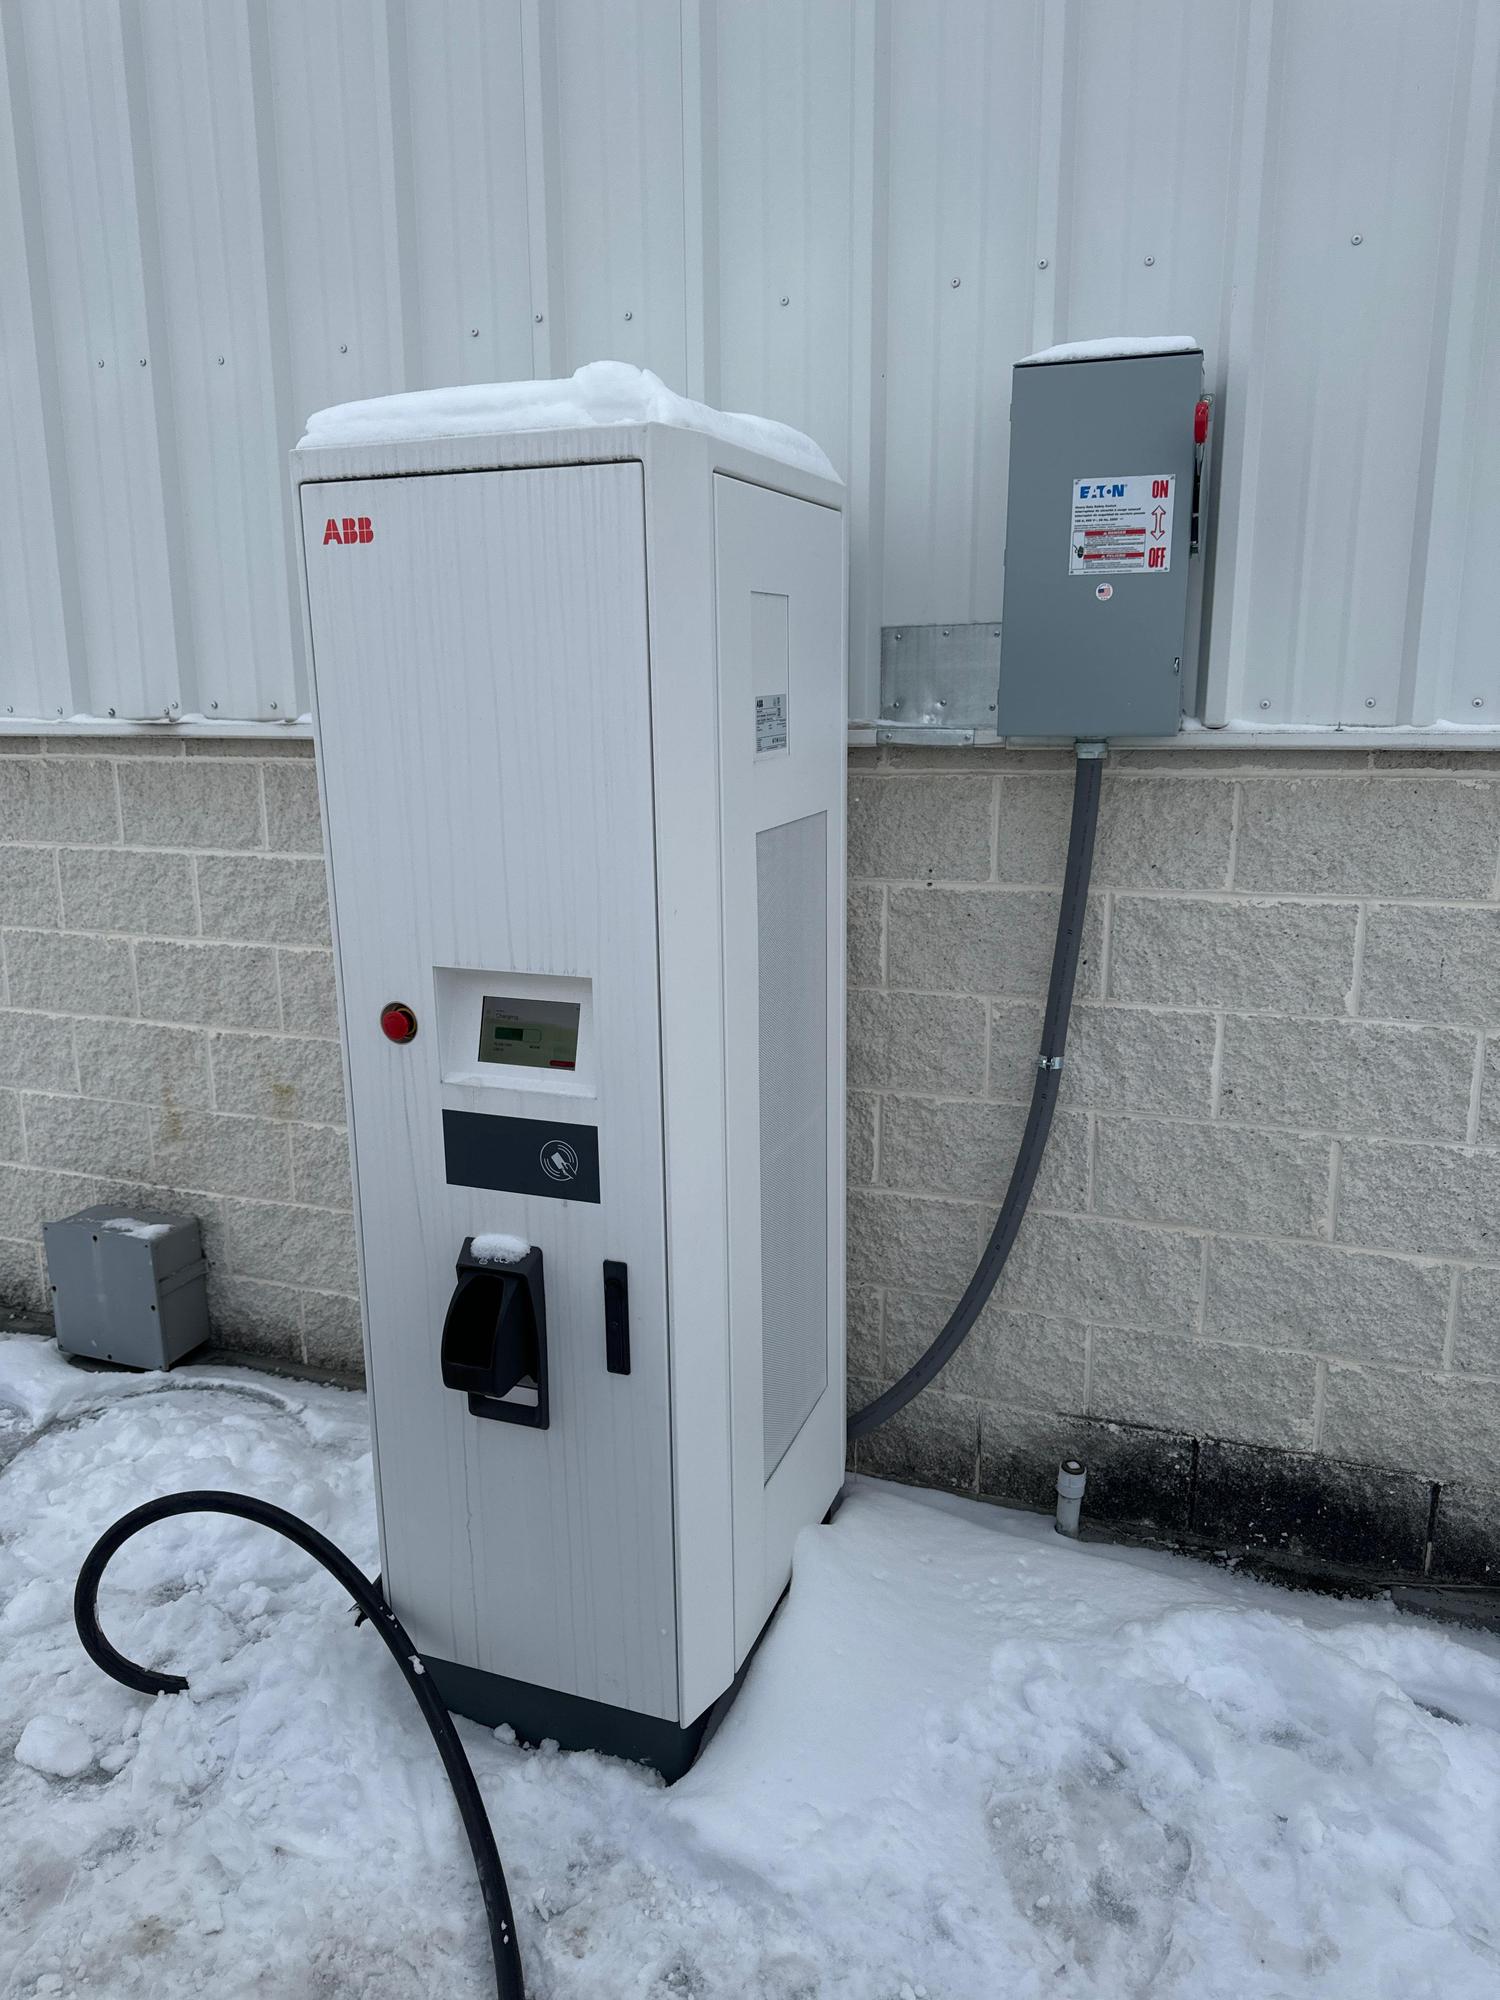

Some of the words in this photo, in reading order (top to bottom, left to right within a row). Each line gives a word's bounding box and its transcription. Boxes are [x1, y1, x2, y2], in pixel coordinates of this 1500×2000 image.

[1080, 484, 1124, 498] EATON
[1151, 480, 1169, 498] ON
[323, 517, 374, 545] ABB
[1148, 547, 1166, 568] OFF
